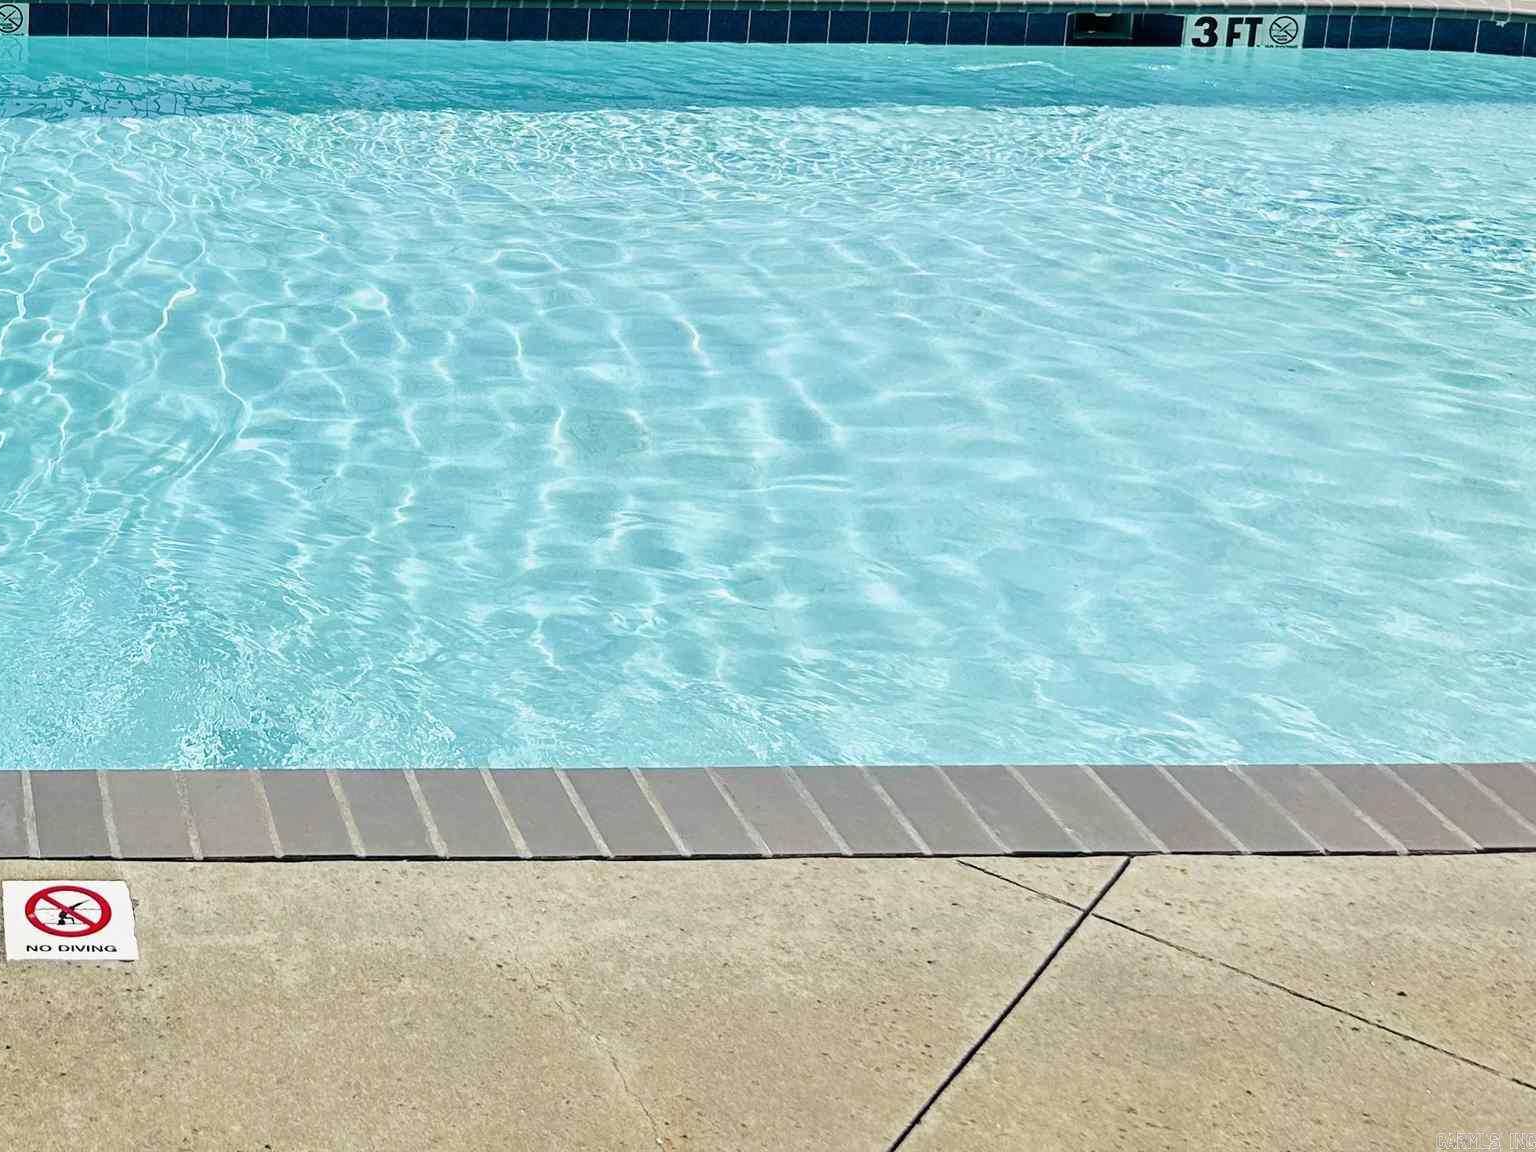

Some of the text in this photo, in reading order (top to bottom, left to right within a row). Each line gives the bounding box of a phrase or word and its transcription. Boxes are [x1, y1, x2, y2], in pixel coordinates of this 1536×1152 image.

[1191, 16, 1264, 48] 3 FT
[26, 944, 118, 953] NO DIVING
